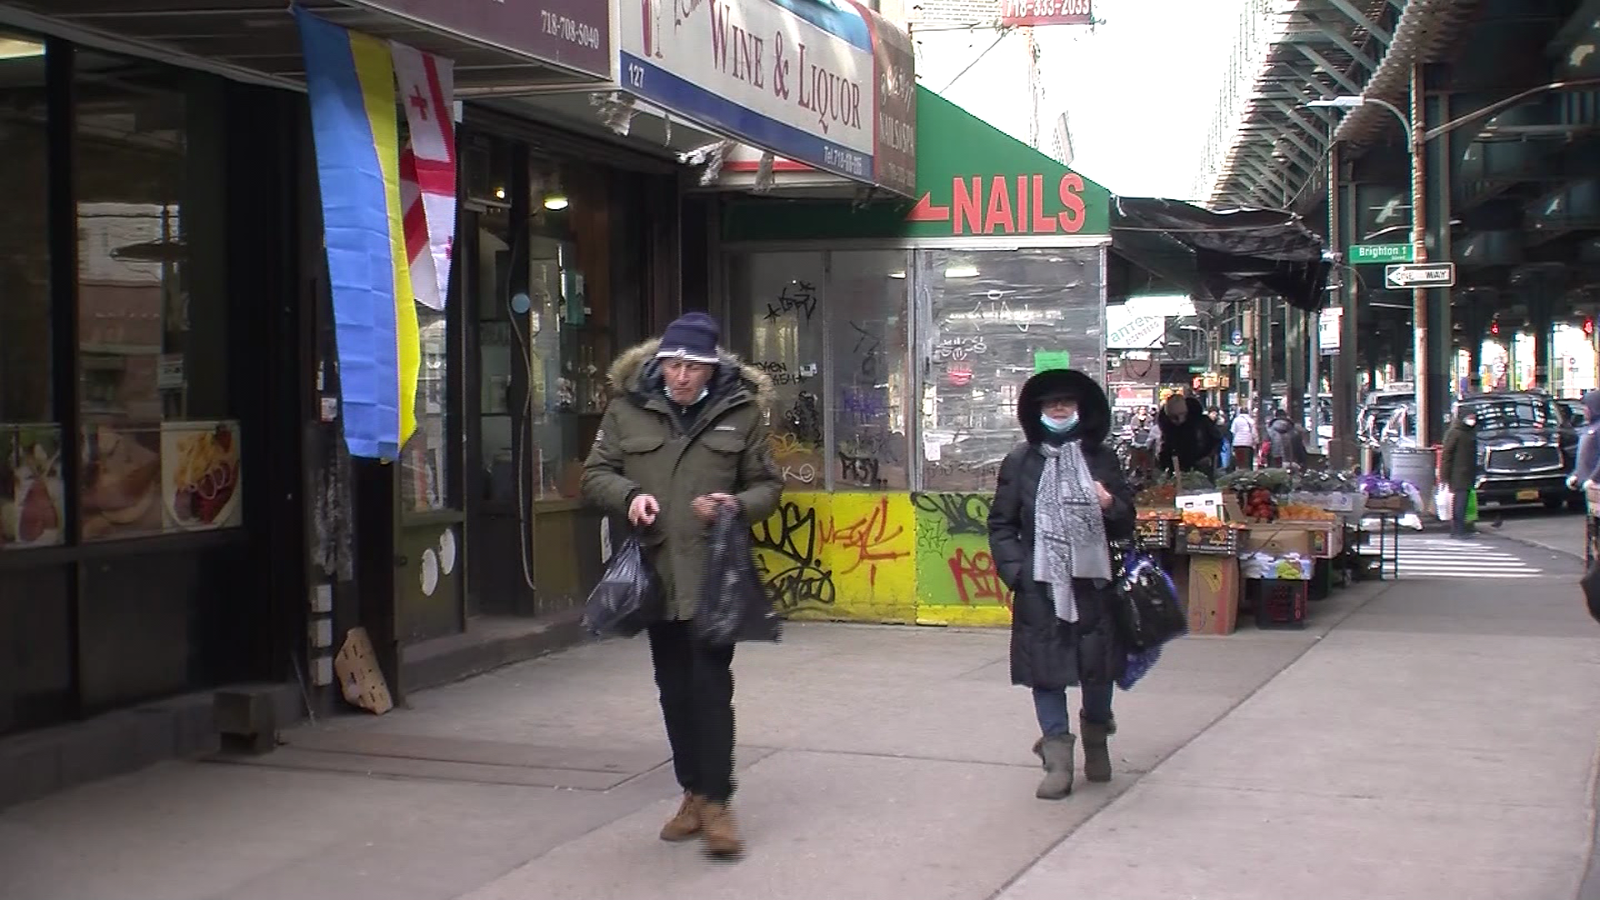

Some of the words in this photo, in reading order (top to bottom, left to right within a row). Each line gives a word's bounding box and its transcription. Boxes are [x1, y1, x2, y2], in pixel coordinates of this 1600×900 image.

[541, 9, 600, 49] 718-708-5040
[628, 62, 645, 89] 127
[773, 30, 790, 101] &
[798, 43, 862, 135] LIQUOR
[953, 172, 1086, 235] NAILS
[1359, 246, 1399, 258] Brighton
[1395, 272, 1414, 281] ONE
[1425, 270, 1447, 279] WAY
